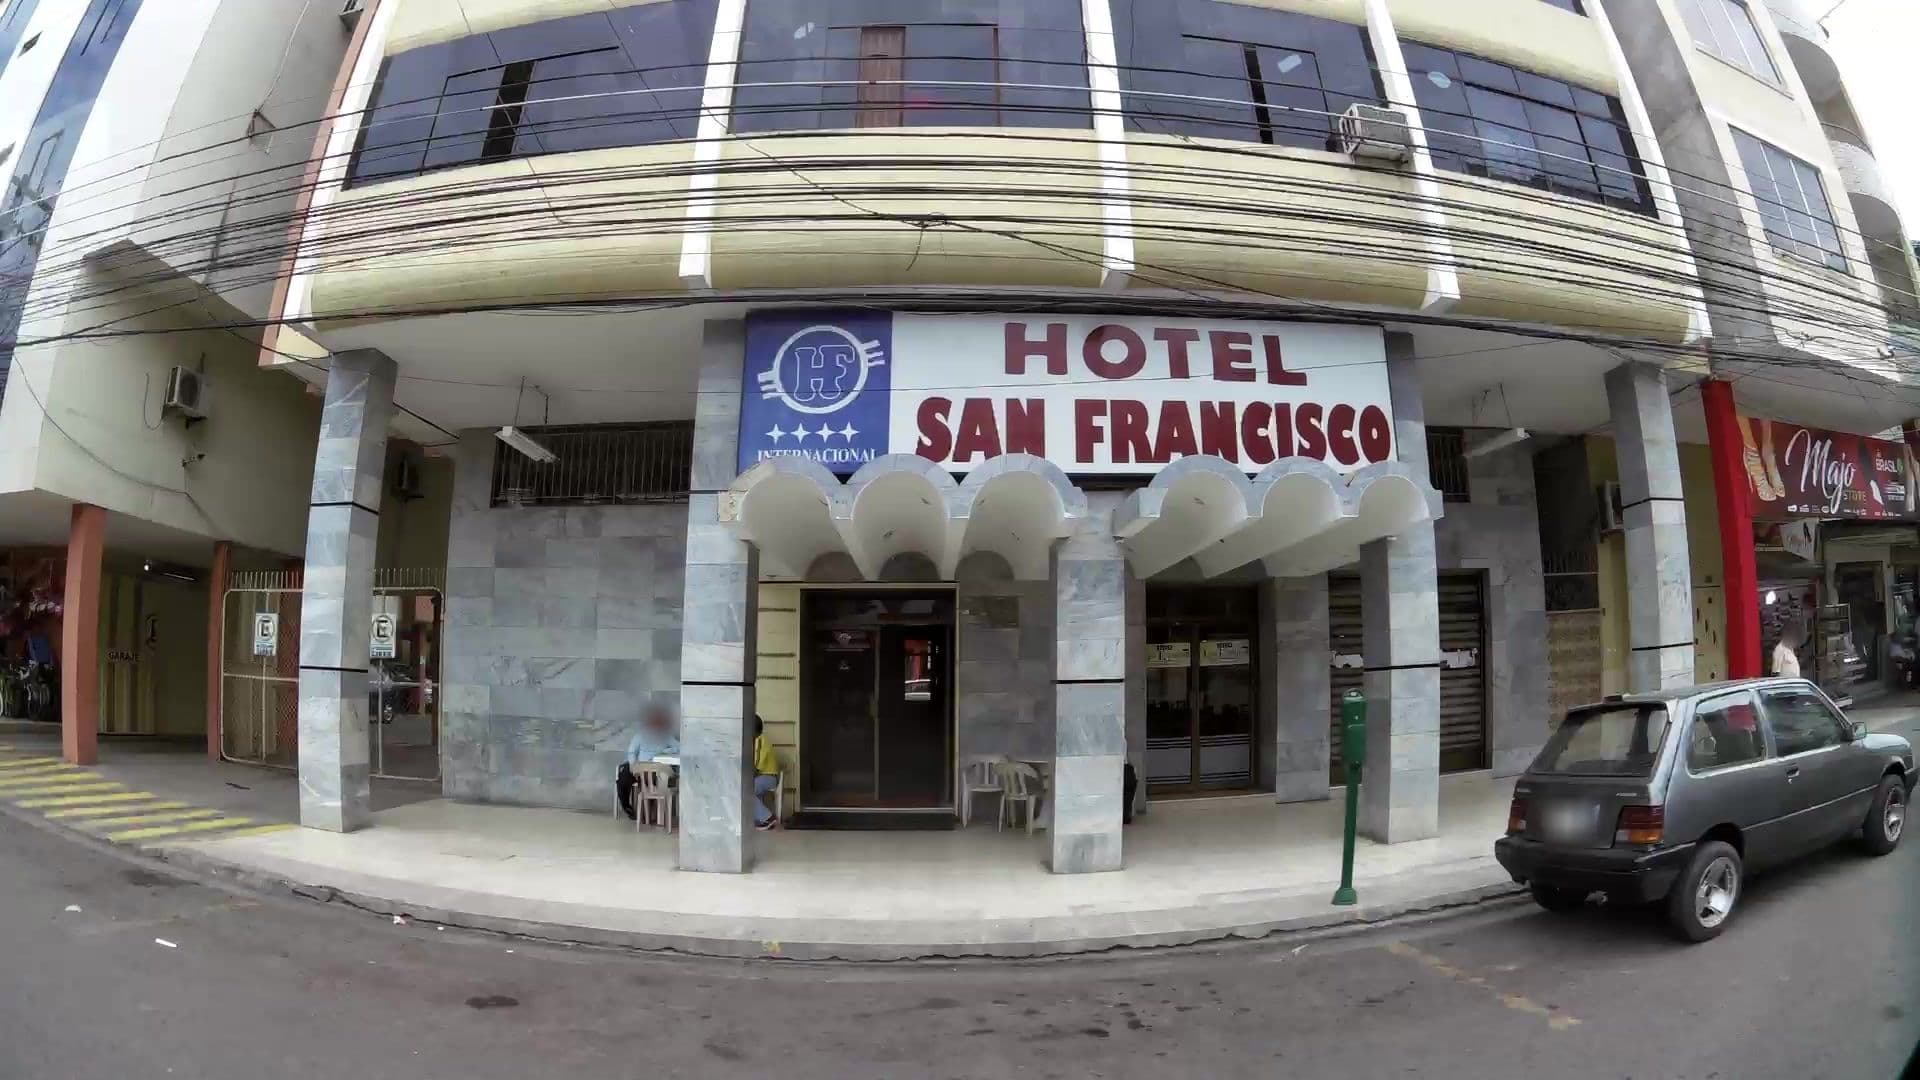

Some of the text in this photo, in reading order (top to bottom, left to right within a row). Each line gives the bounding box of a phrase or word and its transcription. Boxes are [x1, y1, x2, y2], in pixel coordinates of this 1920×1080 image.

[793, 344, 856, 402] HF
[1004, 322, 1308, 386] HOTEL
[915, 397, 1391, 465] SAN FRANCISCO
[1785, 429, 1857, 515] Majo
